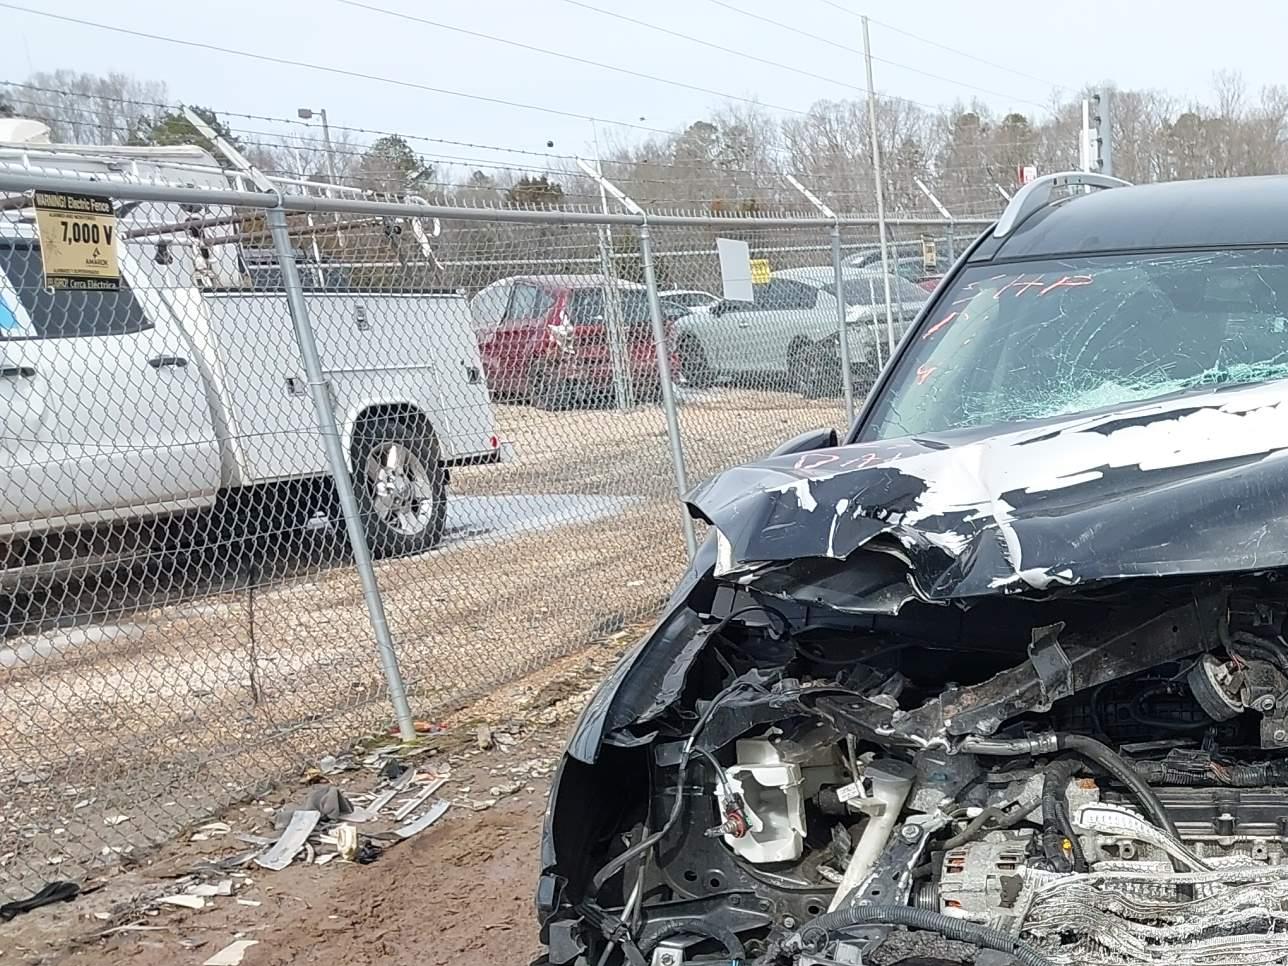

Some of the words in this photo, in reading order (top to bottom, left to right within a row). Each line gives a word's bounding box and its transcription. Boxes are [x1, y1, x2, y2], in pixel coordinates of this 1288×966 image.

[67, 196, 90, 210] Electric
[91, 199, 109, 212] Fence
[61, 221, 99, 246] 7,000
[103, 224, 113, 246] V
[70, 280, 86, 288] Cerca
